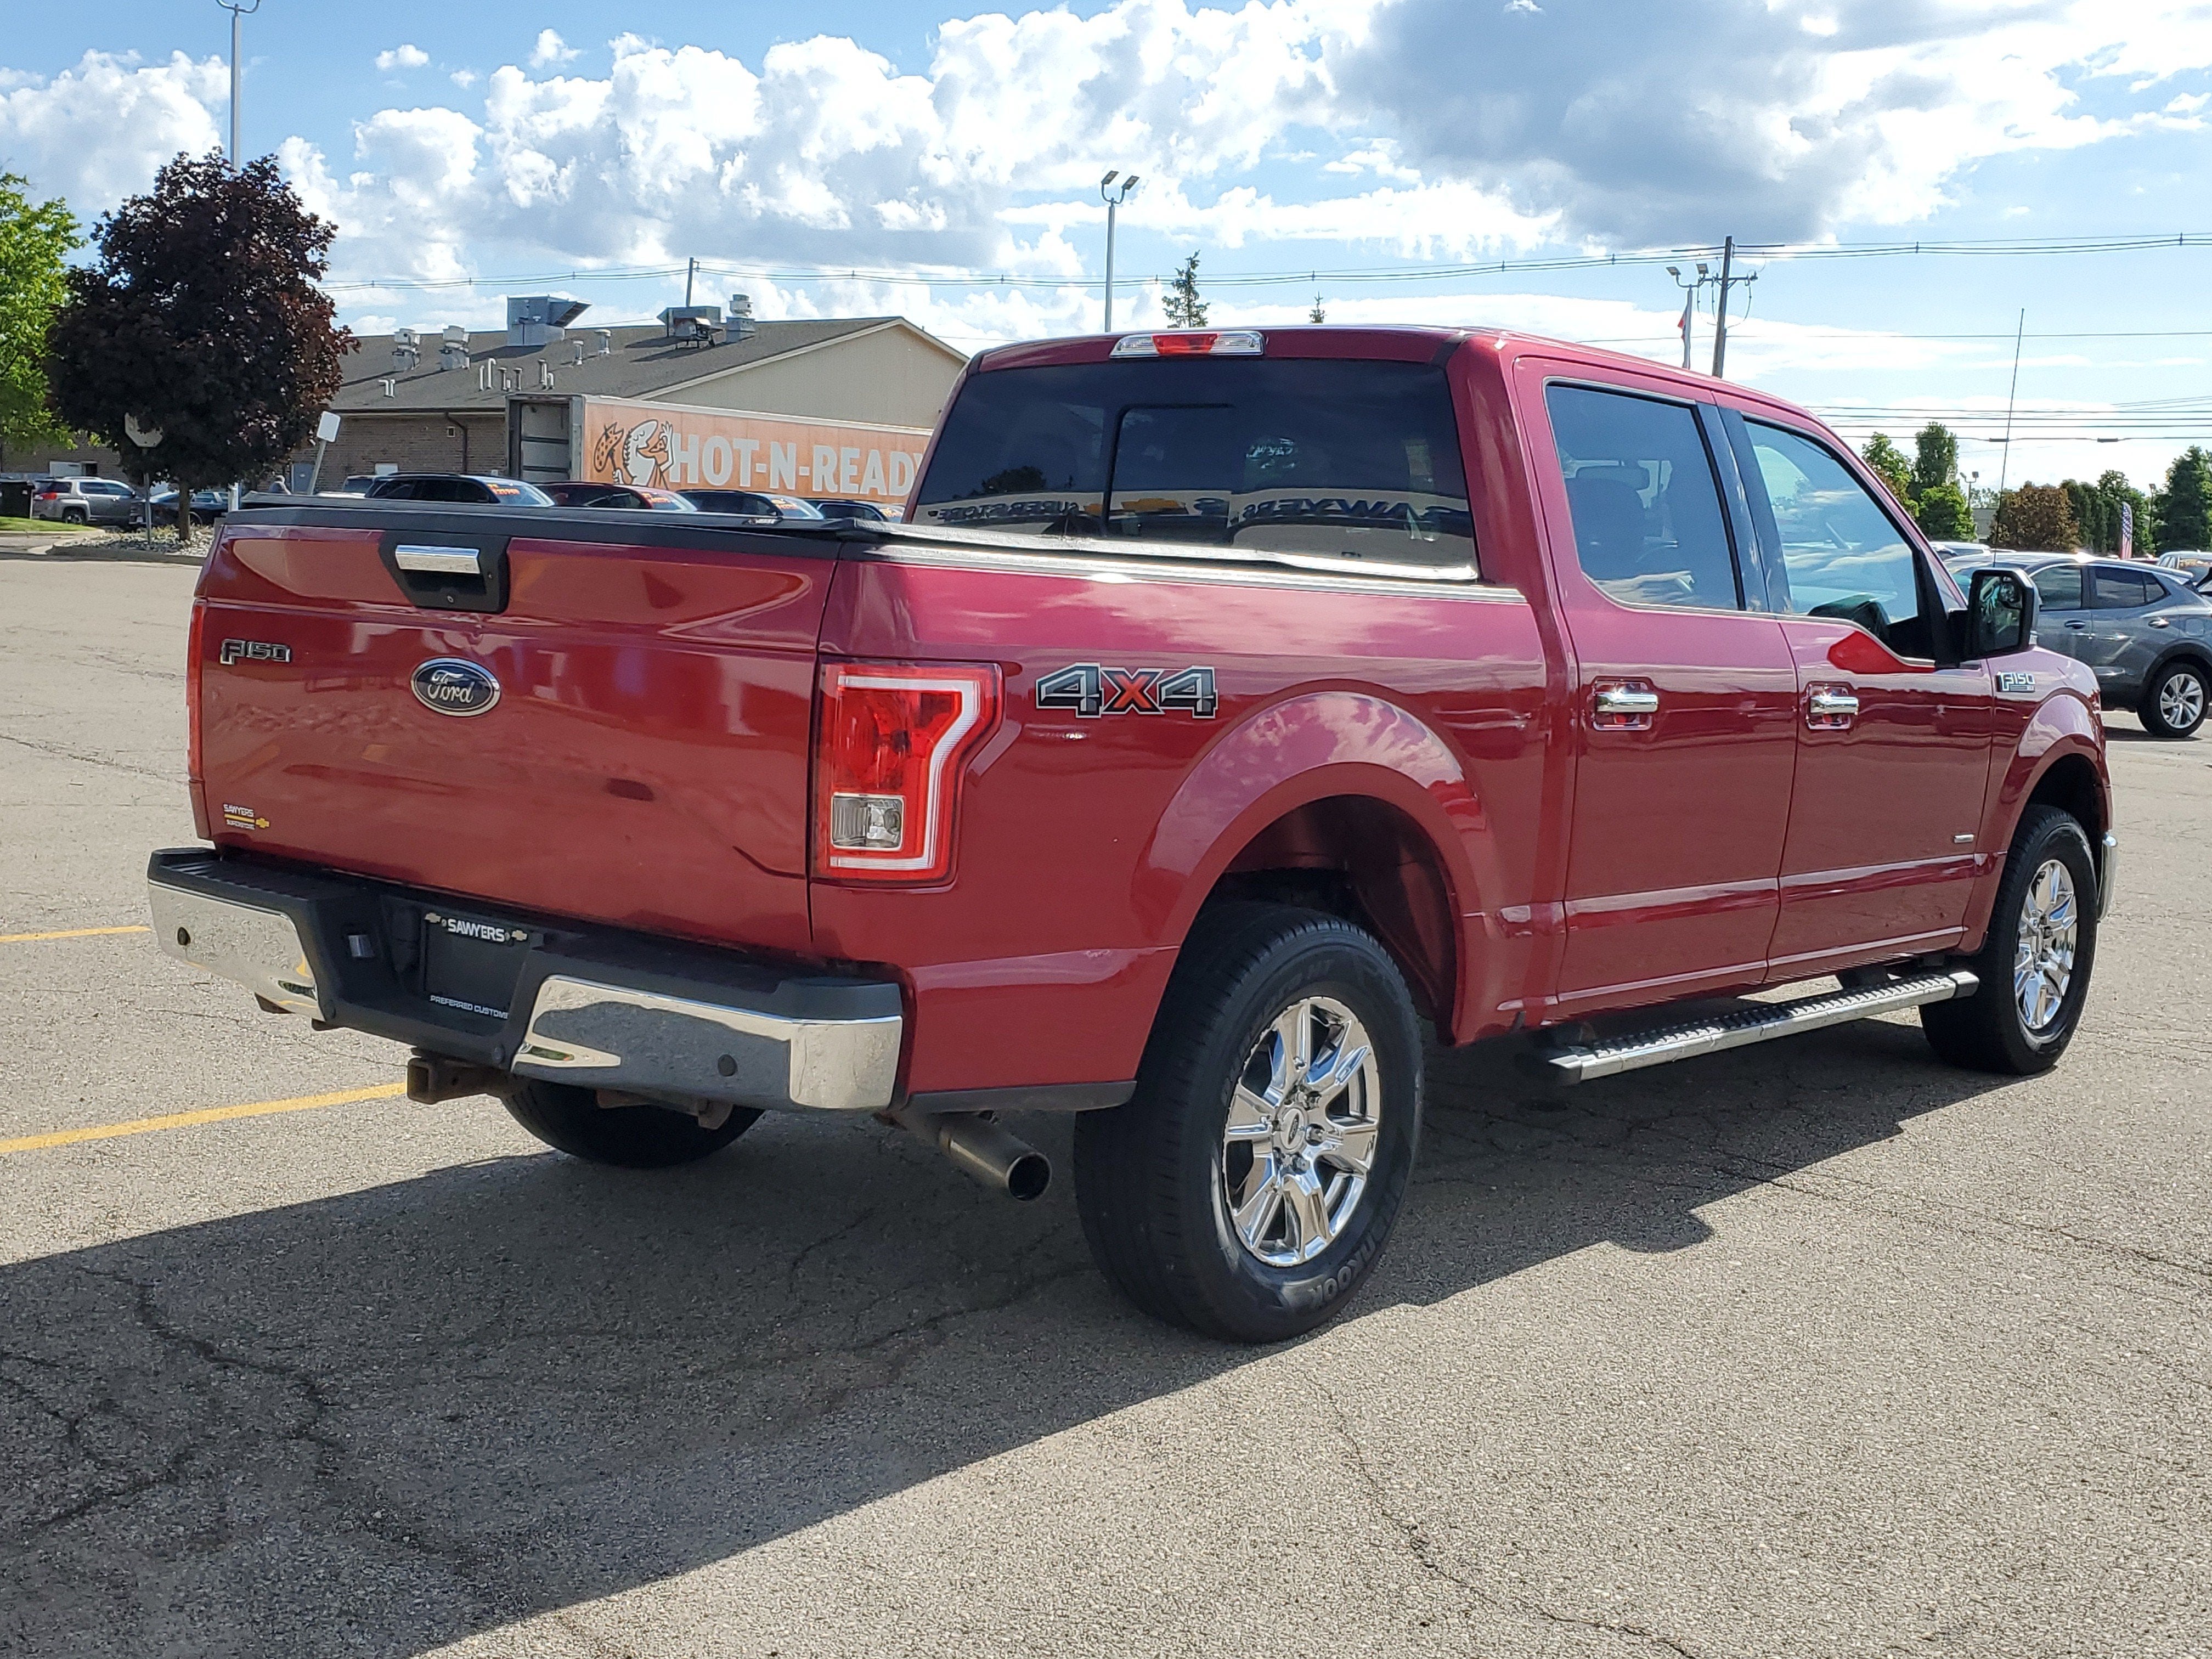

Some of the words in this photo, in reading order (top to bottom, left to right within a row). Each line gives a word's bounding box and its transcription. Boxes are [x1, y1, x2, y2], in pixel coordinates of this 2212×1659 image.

[219, 638, 292, 665] F150
[427, 670, 475, 704] Ford
[1036, 662, 1218, 719] 4X4
[2000, 672, 2036, 691] F150
[447, 918, 505, 943] SAWYERS
[430, 994, 473, 1011] PREFERRED
